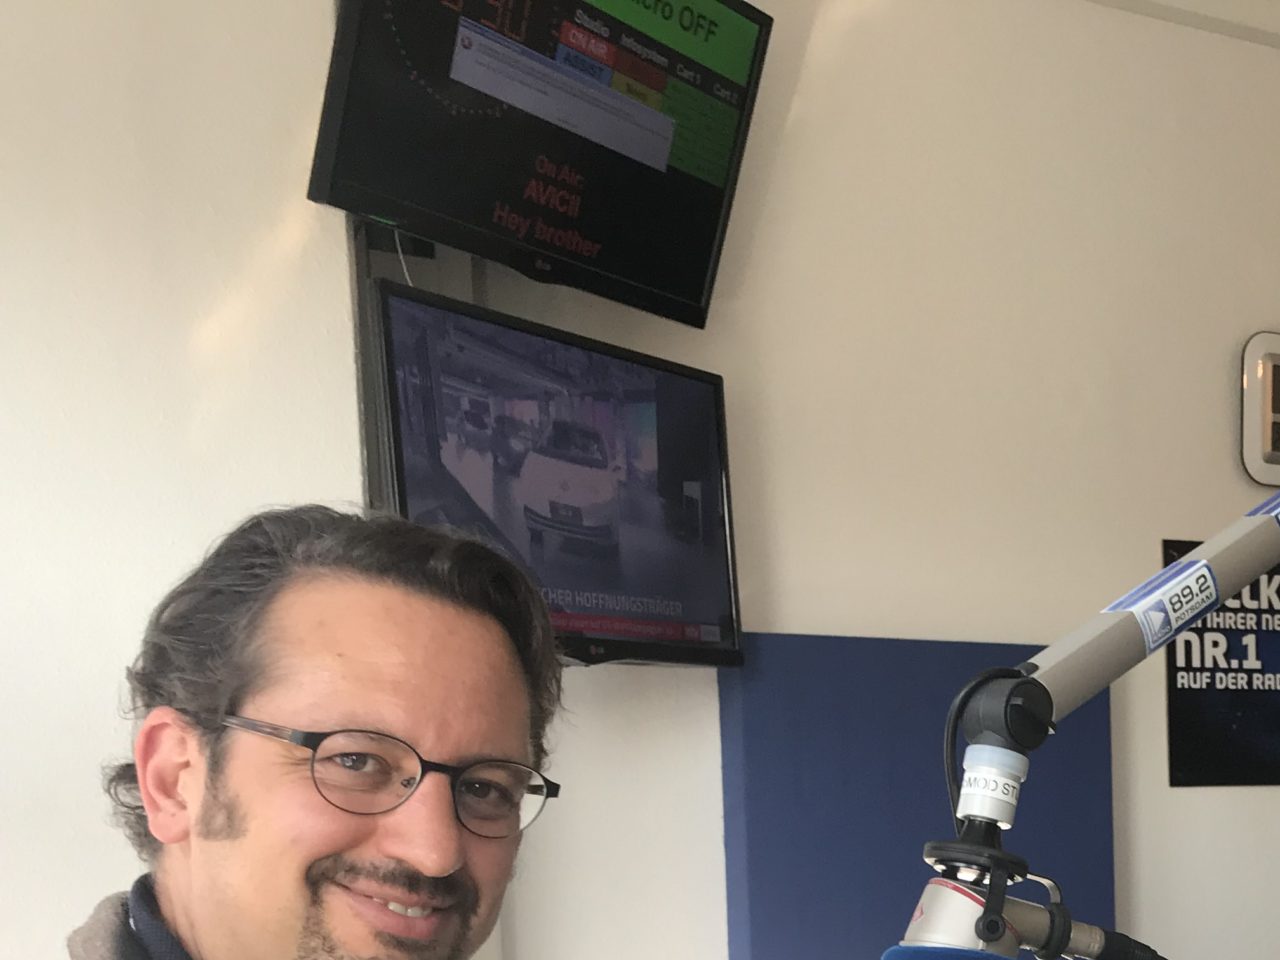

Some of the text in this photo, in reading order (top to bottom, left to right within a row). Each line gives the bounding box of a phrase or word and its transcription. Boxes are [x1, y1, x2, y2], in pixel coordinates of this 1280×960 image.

[631, 0, 719, 42] cro OFF
[492, 201, 602, 257] Hey brother
[541, 587, 573, 607] CHER
[1168, 573, 1211, 614] 89.2
[1174, 591, 1214, 625] POTSDAM
[1206, 611, 1258, 632] IHRER
[1175, 631, 1263, 670] NR.1
[1176, 671, 1212, 689] AUF
[1215, 672, 1249, 690] DER
[962, 776, 999, 793] MOD
